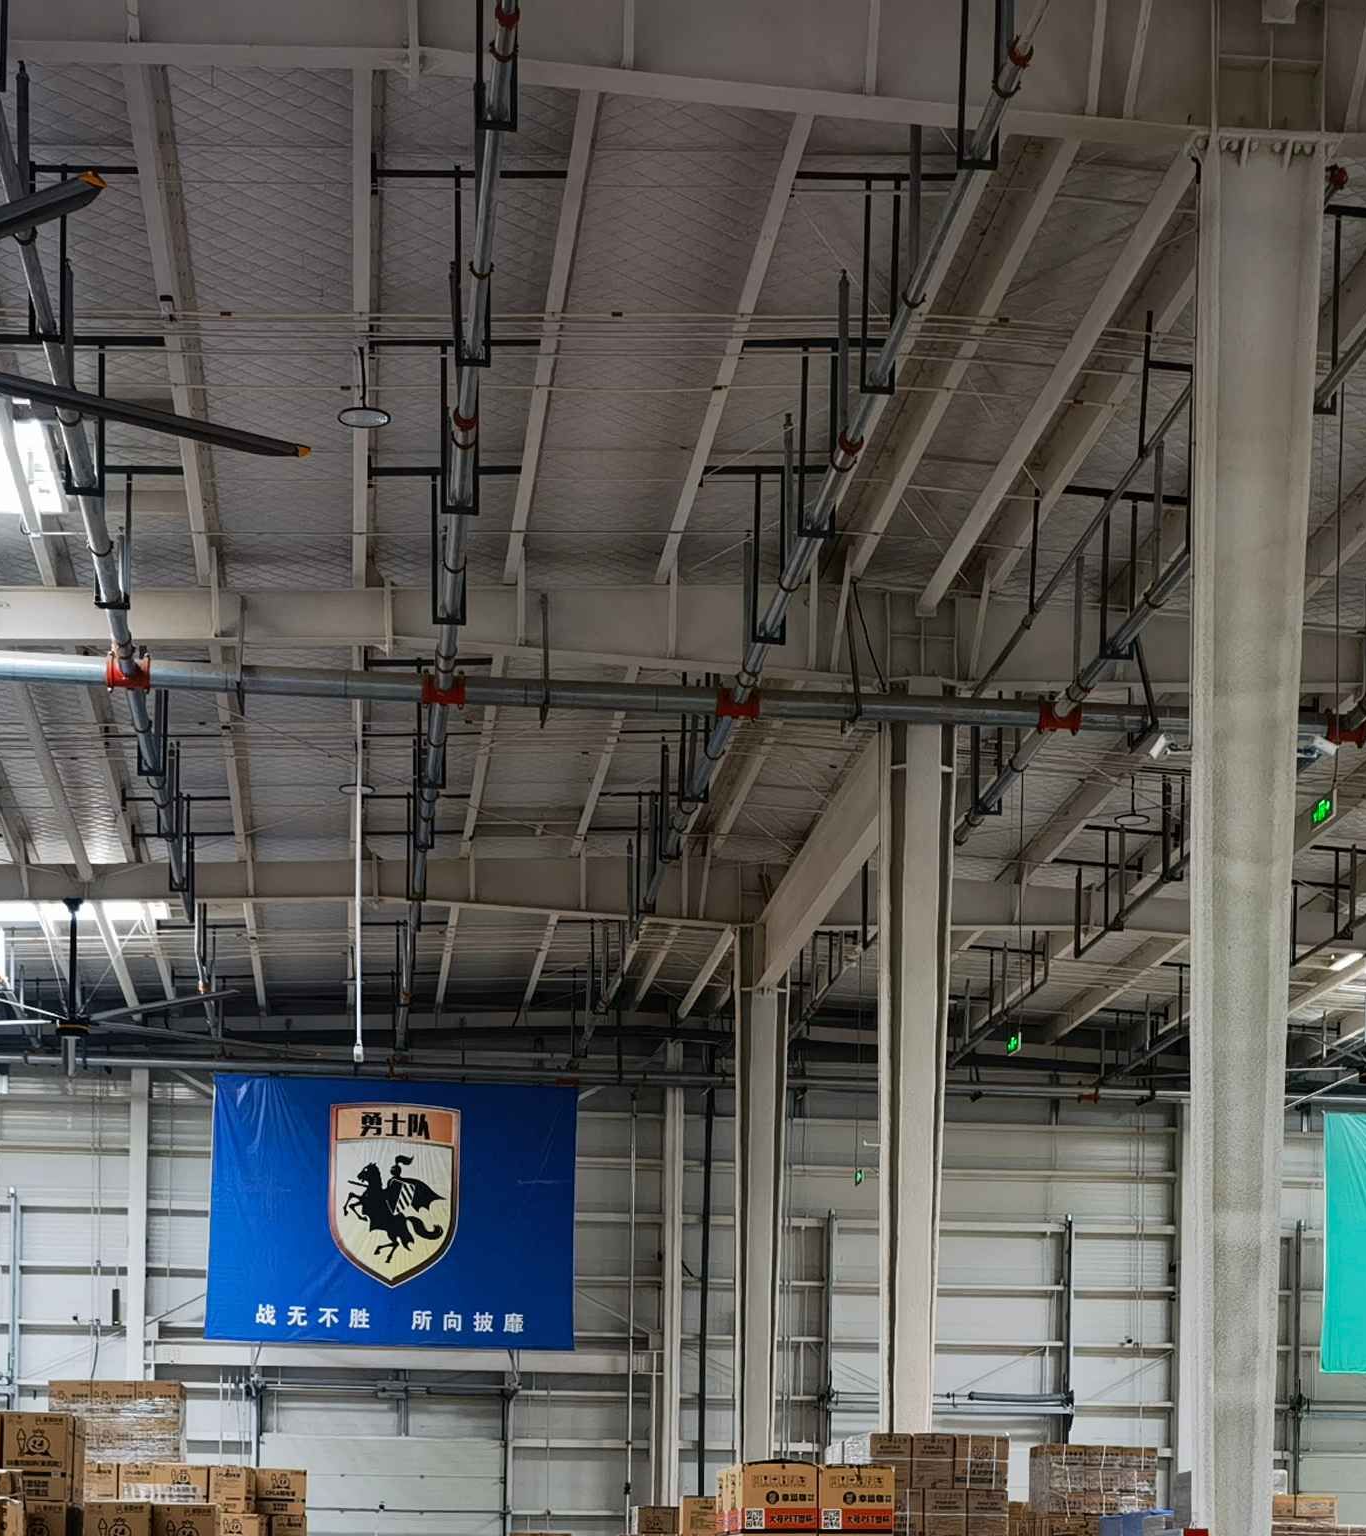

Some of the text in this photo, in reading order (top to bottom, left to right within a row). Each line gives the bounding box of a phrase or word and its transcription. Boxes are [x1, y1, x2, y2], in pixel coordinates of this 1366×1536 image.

[360, 1111, 431, 1140] 勇士队
[255, 1303, 525, 1335] 战无不胜 所向披靡
